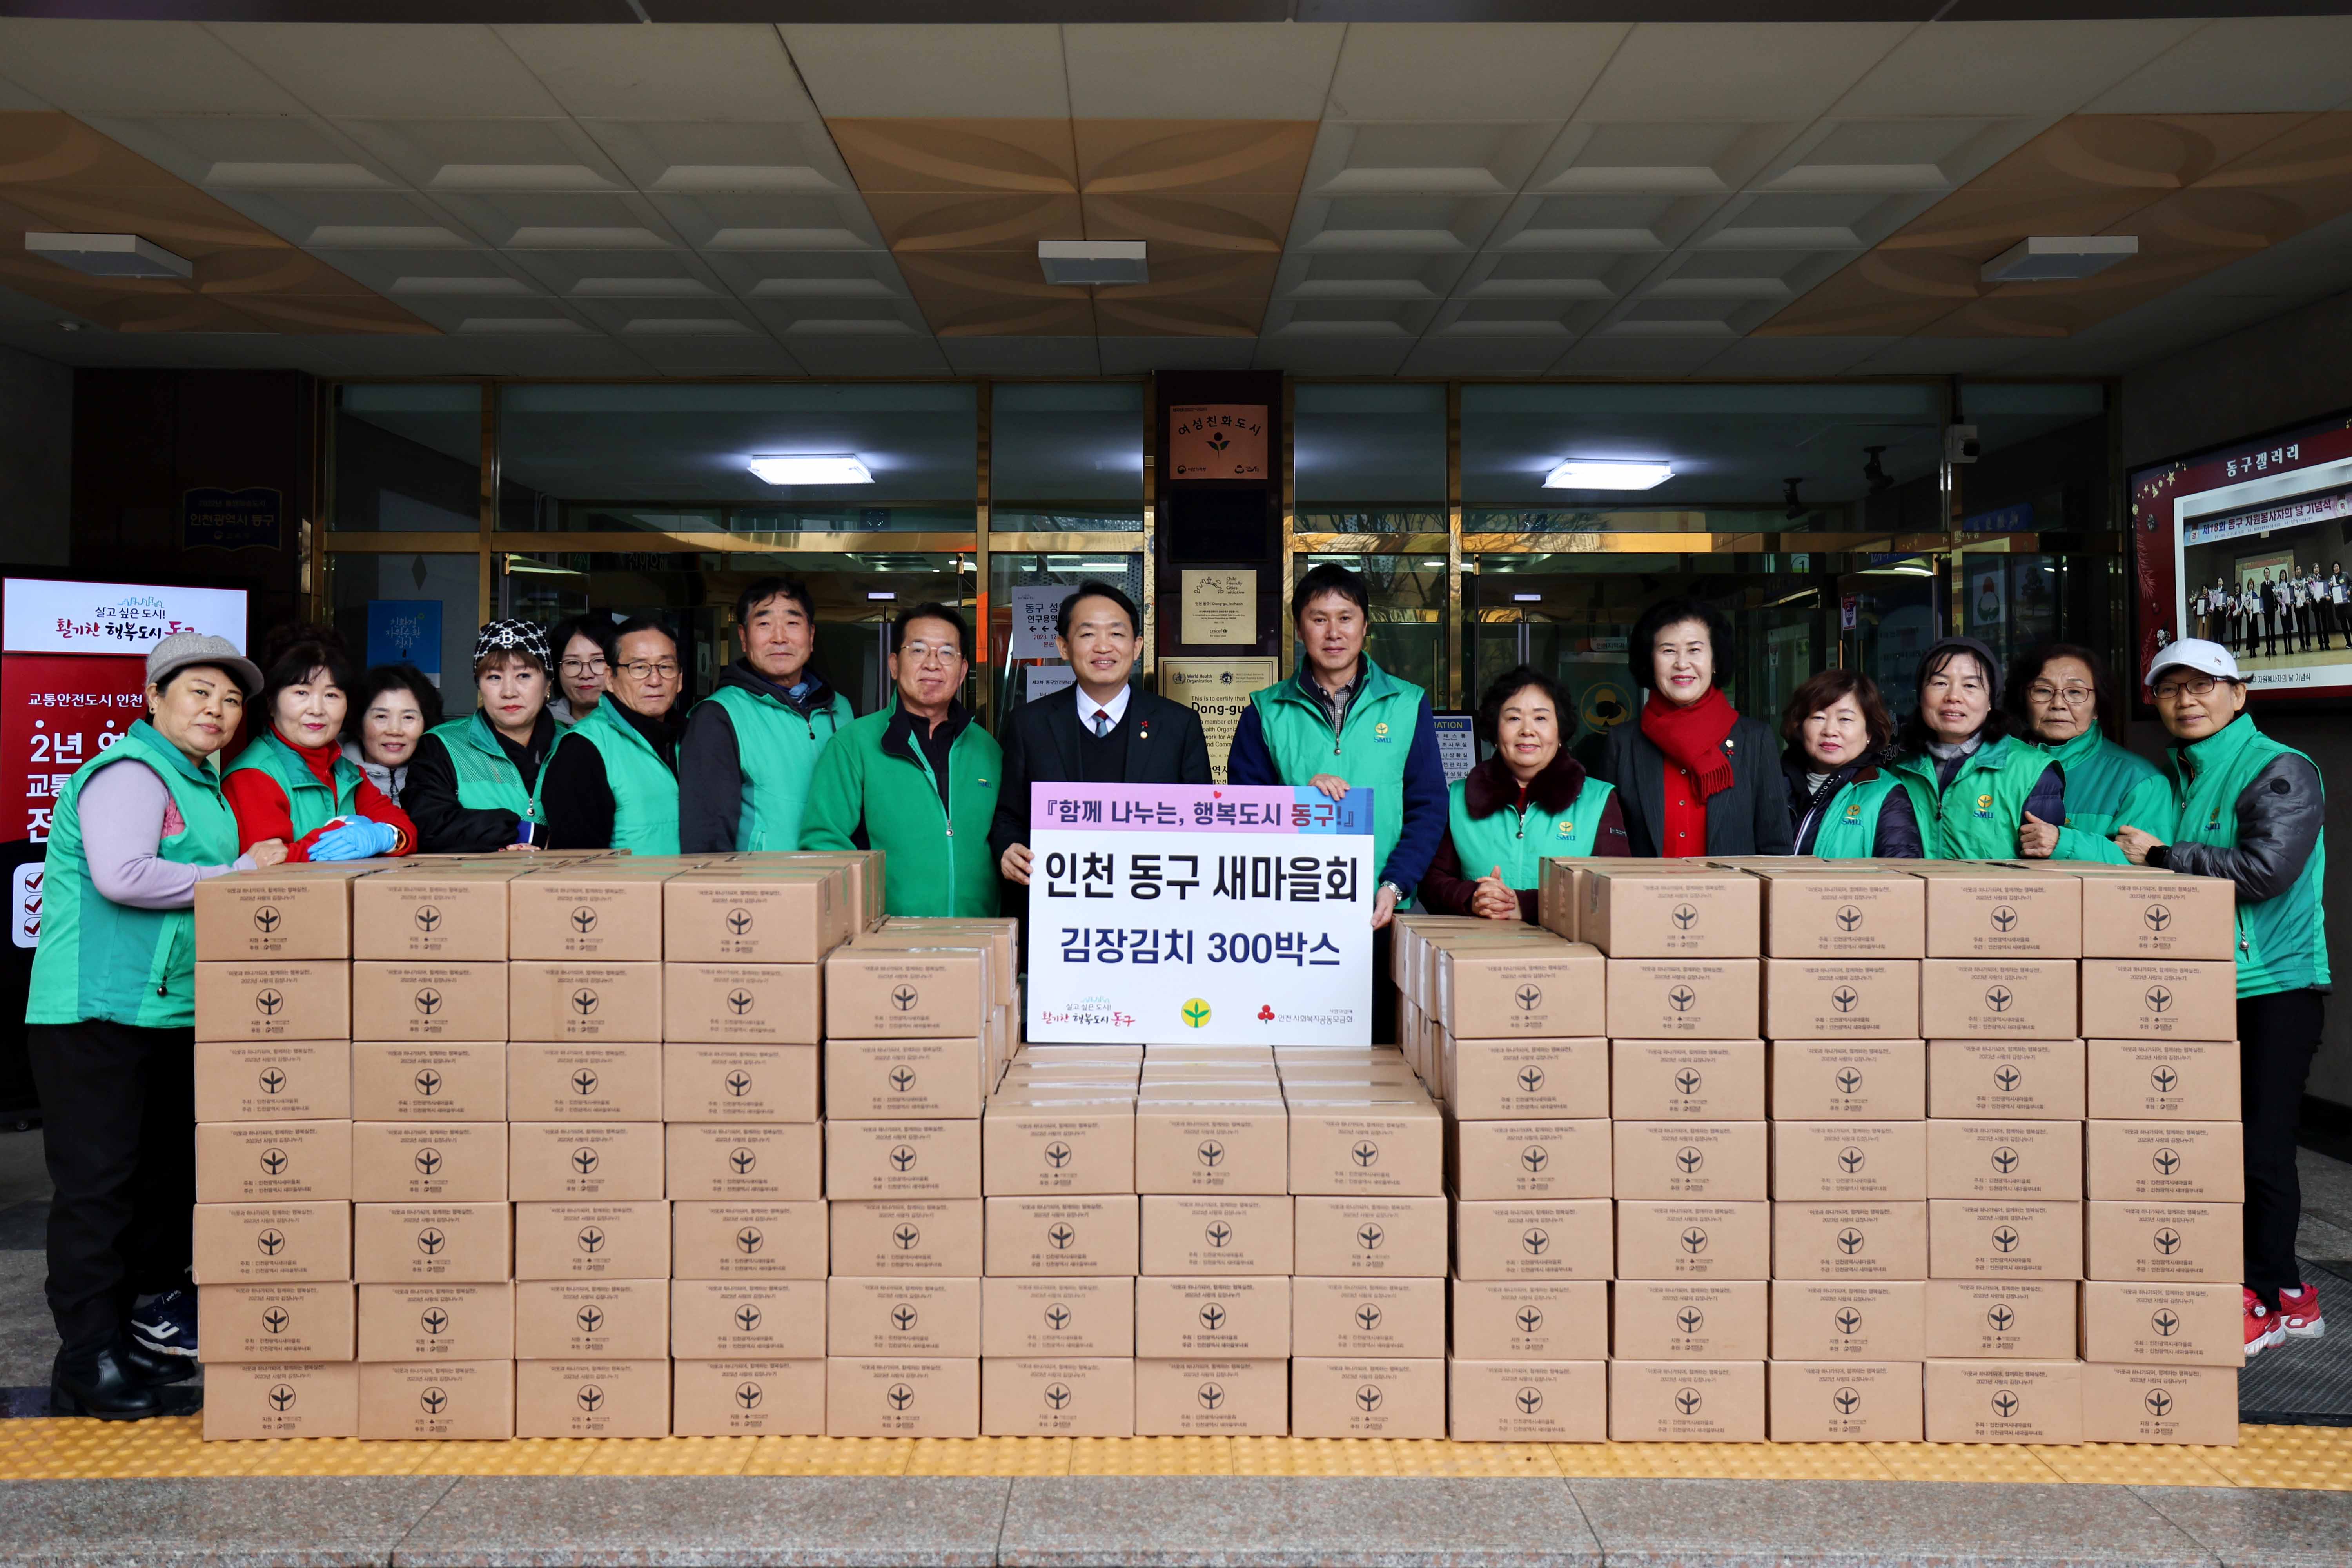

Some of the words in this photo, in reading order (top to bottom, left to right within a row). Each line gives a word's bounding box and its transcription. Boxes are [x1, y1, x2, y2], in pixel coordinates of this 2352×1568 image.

[1178, 415, 1261, 436] 여성친화도시
[2226, 443, 2299, 477] 동구갤러리
[190, 514, 248, 527] 인천광역시
[251, 514, 274, 527] 동구
[2202, 522, 2226, 535] 제18회
[2228, 517, 2243, 530] 동구
[2245, 508, 2292, 526] 자원봉사자의
[2295, 505, 2303, 516] 날
[2307, 499, 2332, 514] 기념식
[95, 606, 116, 618] 살고
[119, 606, 140, 620] 싶은
[142, 607, 166, 620] 도시!
[1025, 603, 1044, 613] 동구
[1027, 615, 1058, 623] 연구용역
[56, 618, 100, 639] 활기찬
[105, 622, 162, 641] 행복도시
[499, 630, 514, 645] B
[2258, 674, 2287, 684] 자원봉사자의
[2288, 673, 2294, 682] 날
[2295, 673, 2310, 681] 기념식
[28, 693, 113, 708] 교통안전도시
[116, 694, 142, 708] 인천
[30, 731, 83, 764] 2년
[1047, 799, 1102, 824] 『함께
[1112, 800, 1185, 827] 나누는,
[1194, 800, 1281, 826] 행복도시
[1290, 802, 1354, 829] 동구!』
[1973, 810, 1995, 818] SMU
[2203, 822, 2221, 832] SMU
[1046, 851, 1114, 899] 인천
[1129, 854, 1200, 900] 동구
[1213, 855, 1357, 902] 새마을회
[1060, 927, 1193, 965] 김장김치
[1207, 931, 1341, 966] 300박스
[1042, 1011, 1069, 1024] 활기찬
[1072, 1013, 1109, 1025] 행복도시
[1111, 1011, 1136, 1027] 동구
